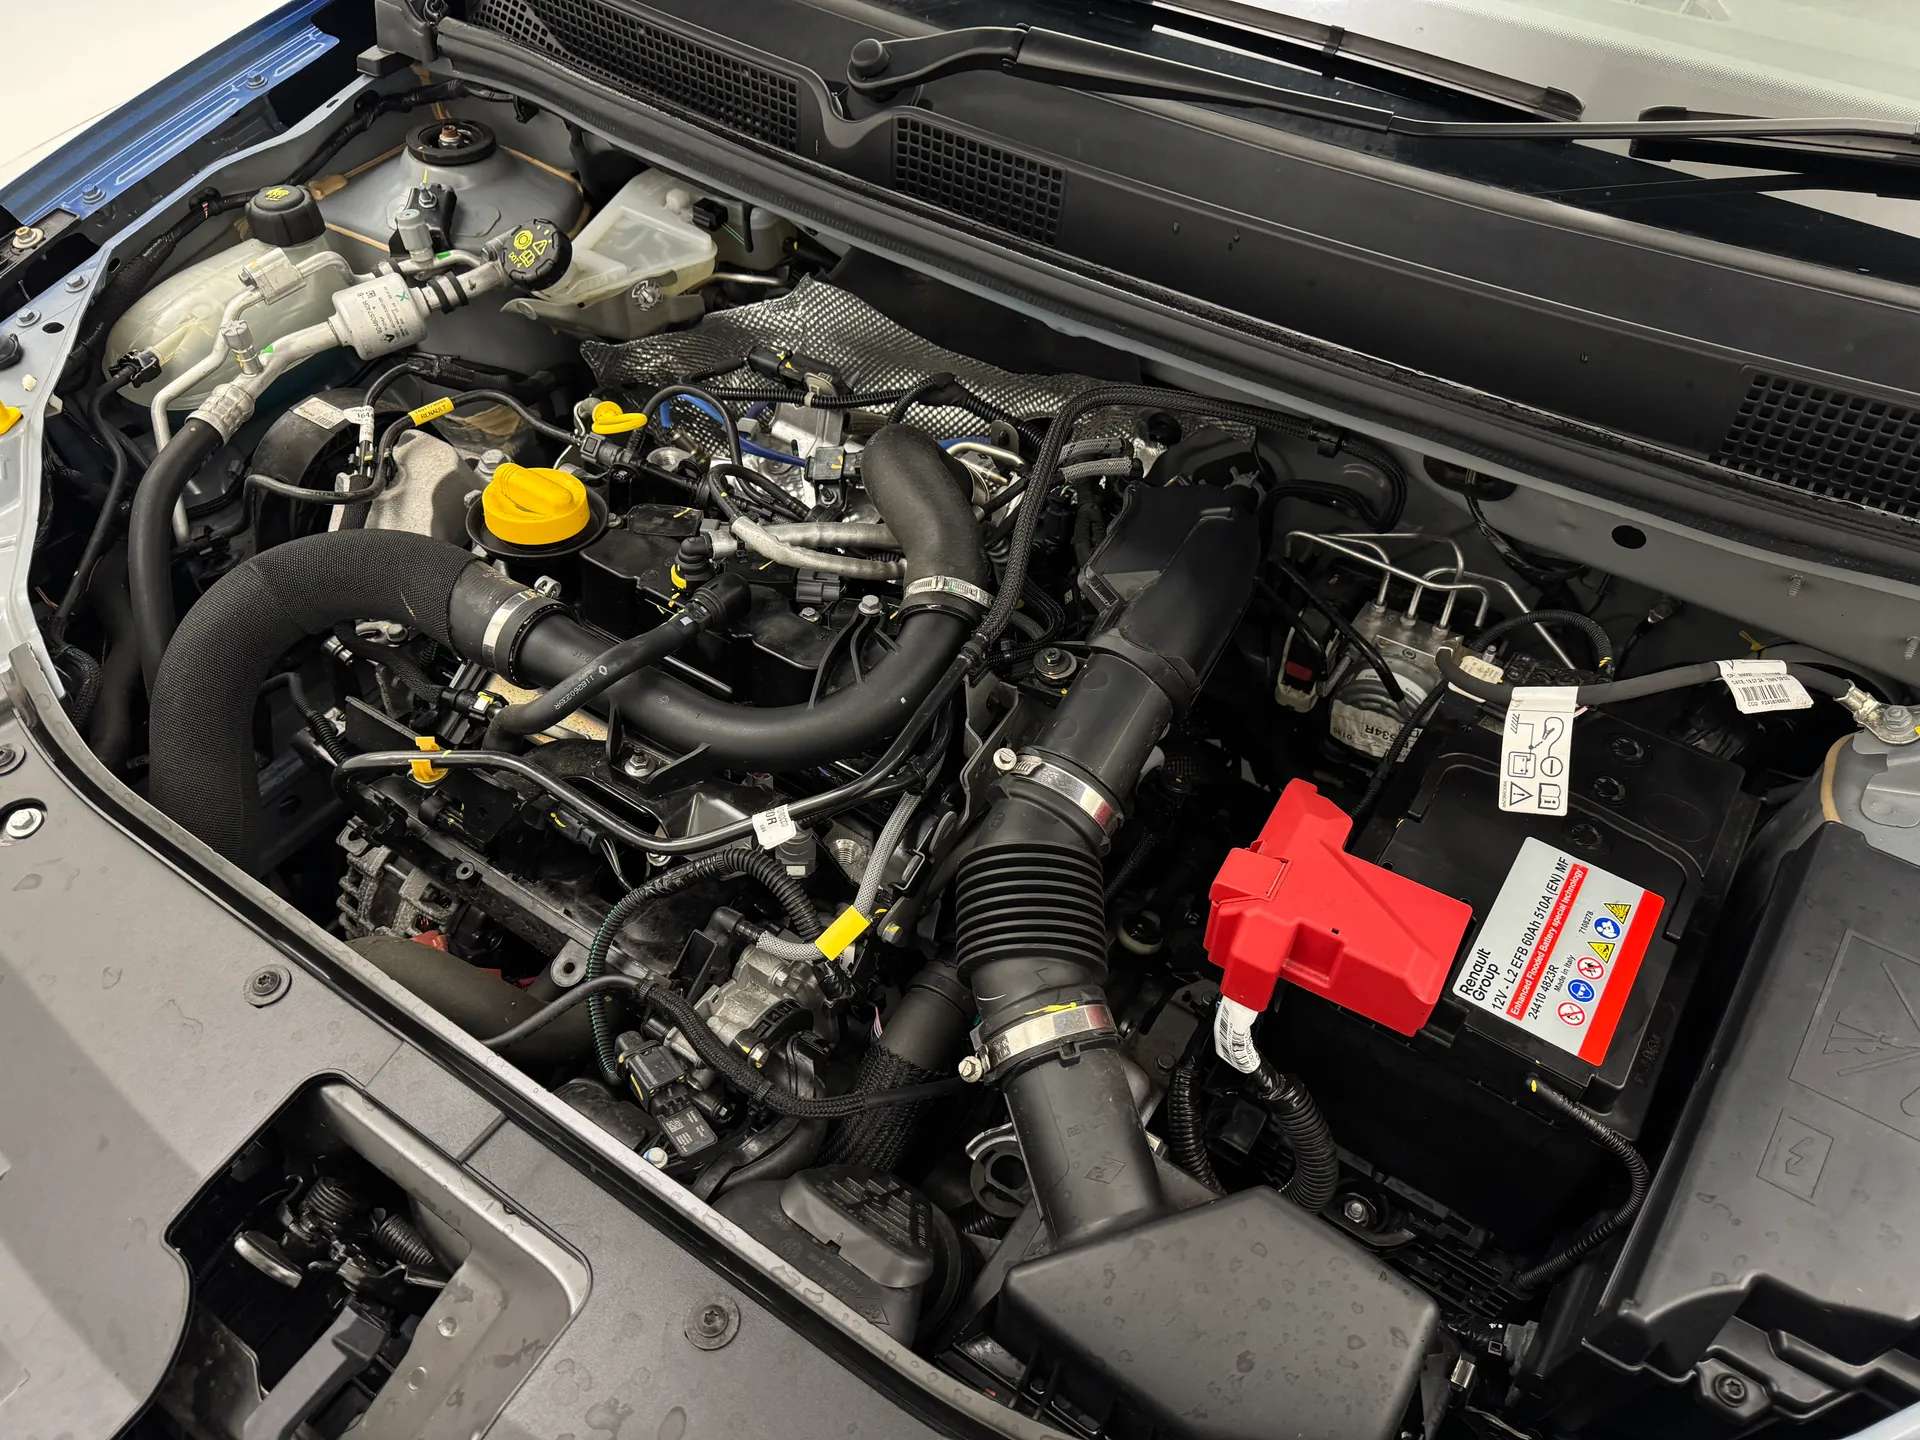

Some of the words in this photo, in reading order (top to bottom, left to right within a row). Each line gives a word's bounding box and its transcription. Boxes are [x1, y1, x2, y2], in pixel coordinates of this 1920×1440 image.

[1492, 990, 1507, 1009] 12V
[1504, 969, 1518, 984] L2
[1511, 947, 1528, 969] EFB
[1522, 921, 1541, 946] 60Ah
[1534, 896, 1552, 919] 510A
[1545, 874, 1564, 895] (EN)
[1555, 857, 1568, 873] MF
[1511, 979, 1532, 1015] Enhanced
[1527, 951, 1544, 979] Flooded
[1539, 927, 1557, 951] Battery
[1552, 903, 1567, 927] special
[1562, 869, 1583, 903] technology
[1459, 948, 1491, 995] Renault
[1473, 964, 1500, 1001] Group
[1528, 993, 1546, 1019] 24410
[1541, 965, 1559, 992] 4823R
[1554, 976, 1565, 992] Made
[1564, 955, 1575, 968] Italy
